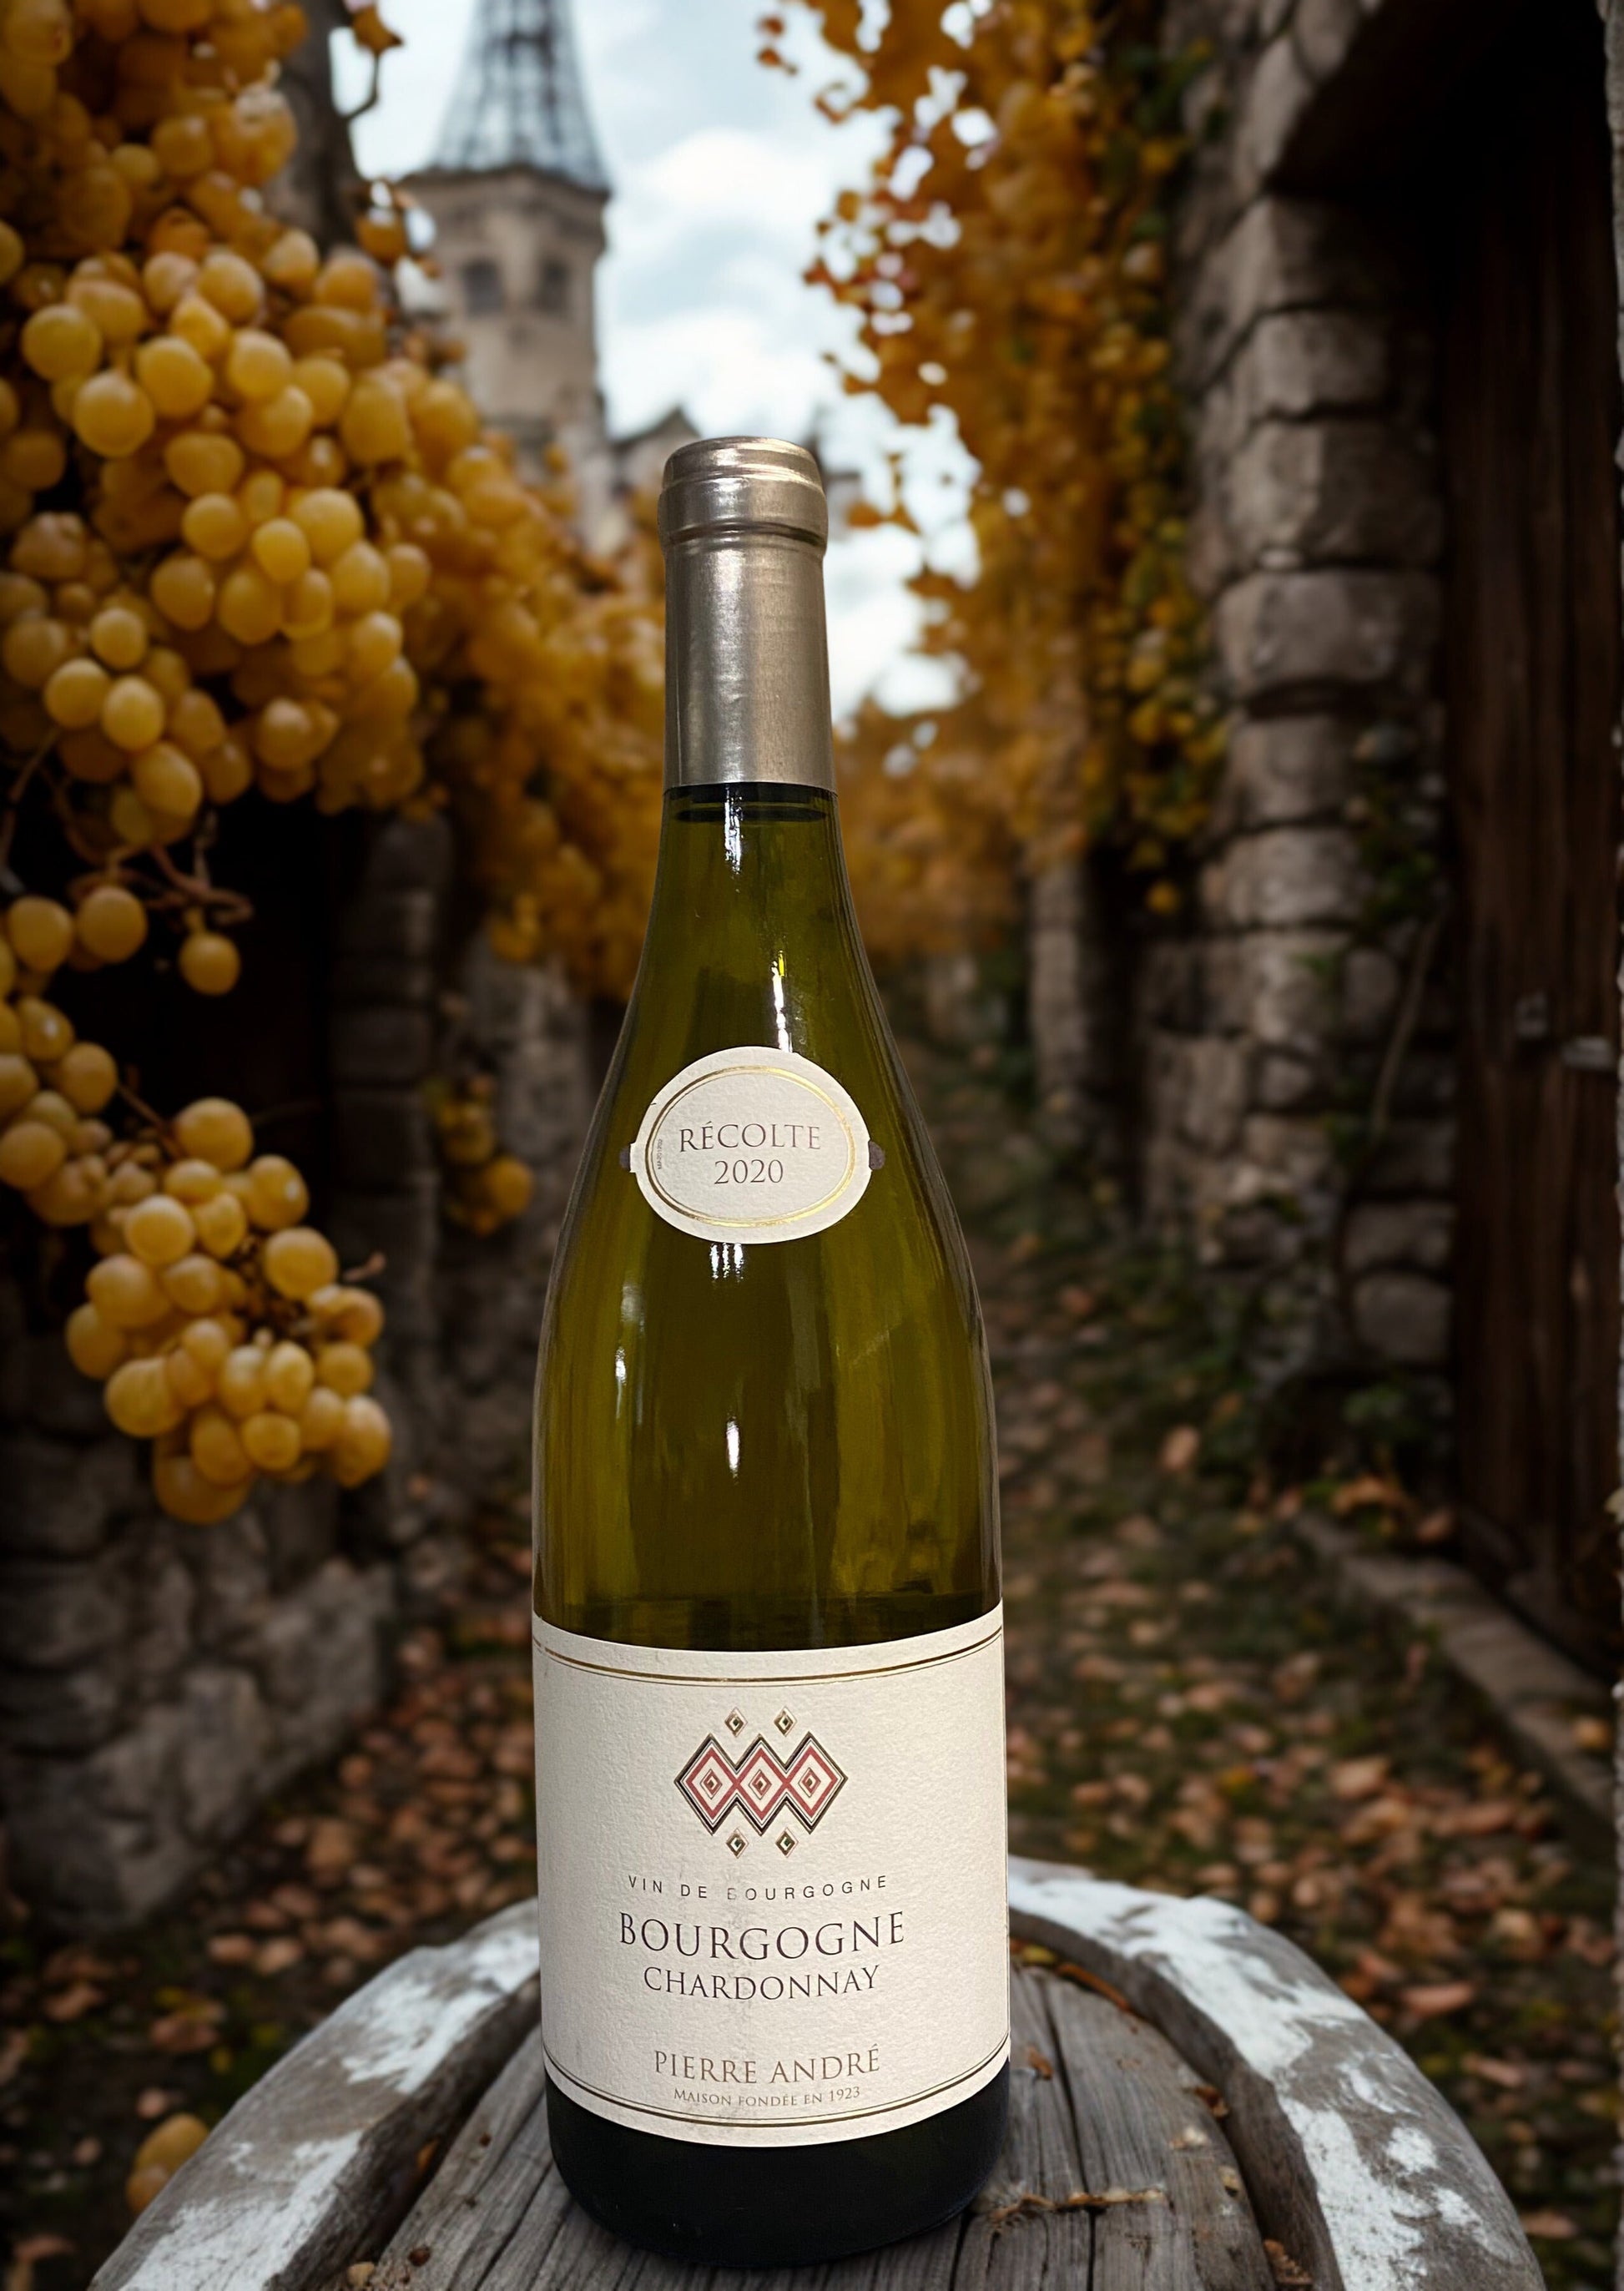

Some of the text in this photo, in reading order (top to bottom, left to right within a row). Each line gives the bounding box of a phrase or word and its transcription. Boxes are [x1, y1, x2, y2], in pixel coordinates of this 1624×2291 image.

[679, 1121, 820, 1152] RÉCOLTE
[714, 1159, 783, 1183] 2020
[628, 1875, 662, 1893] VIN
[681, 1884, 707, 1898] DE
[620, 1911, 904, 1960] BOURGOGNE
[644, 1966, 880, 2000] CHARDONNAY
[655, 2044, 880, 2083] PIERRE ANDRÉ
[674, 2088, 731, 2106] MAISON
[804, 2093, 822, 2104] EN
[830, 2087, 860, 2101] 1923
